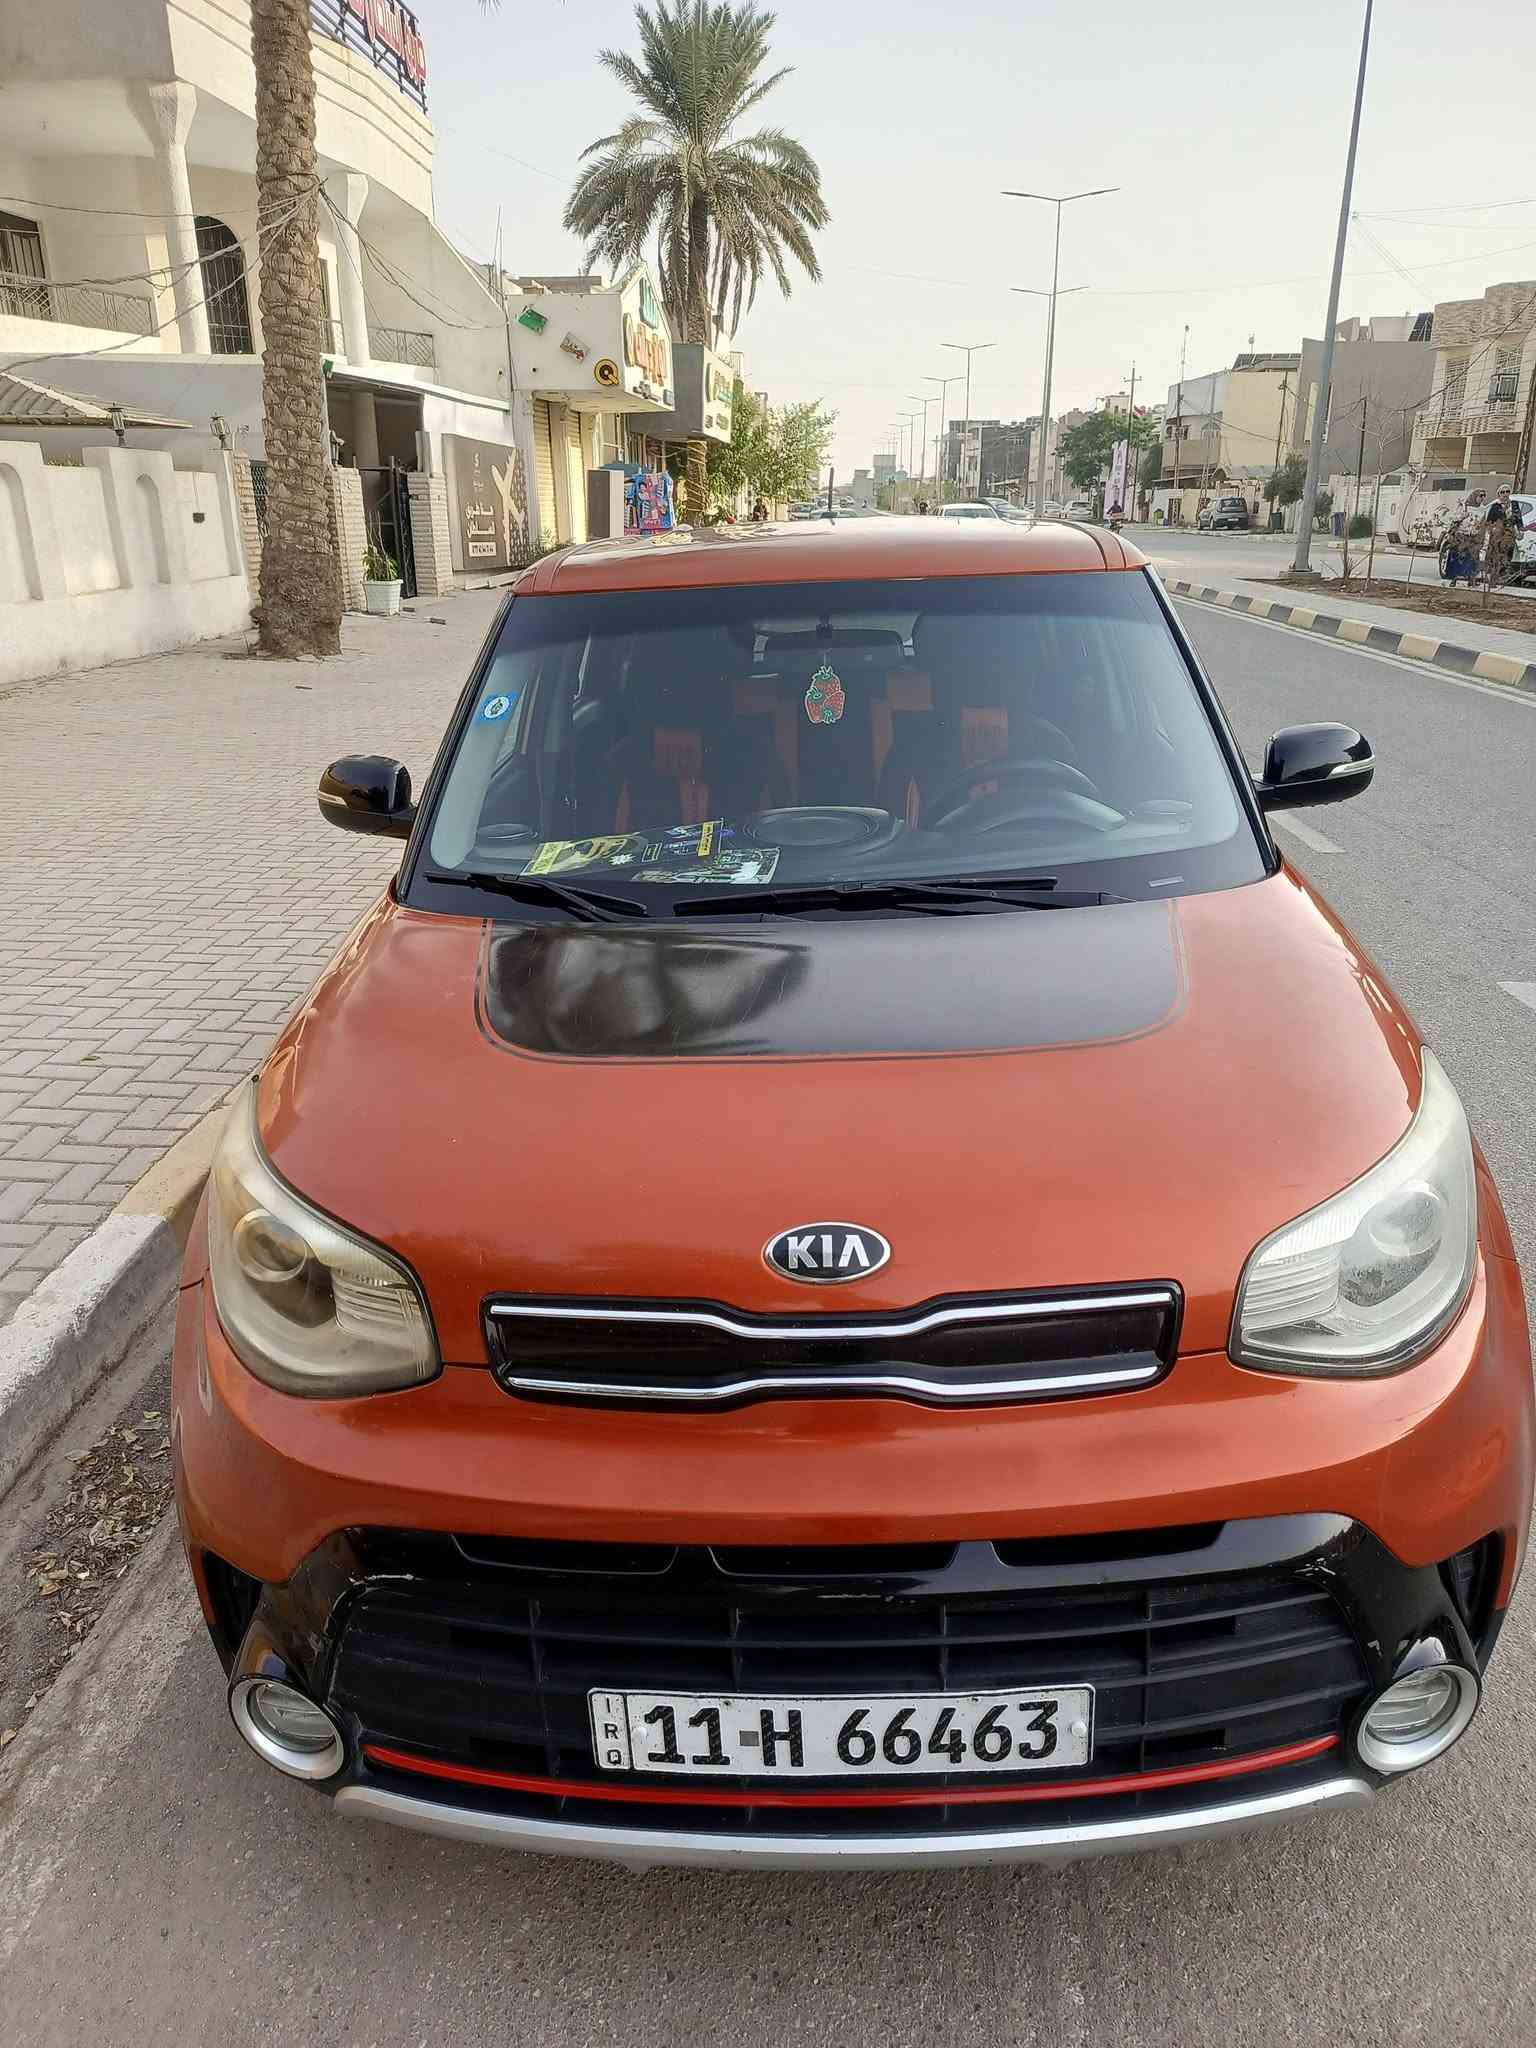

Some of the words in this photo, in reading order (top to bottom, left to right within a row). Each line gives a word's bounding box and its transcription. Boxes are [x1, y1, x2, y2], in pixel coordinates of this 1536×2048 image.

[787, 1235, 870, 1268] KIA
[760, 1709, 804, 1767] H
[837, 1700, 1059, 1767] 66463
